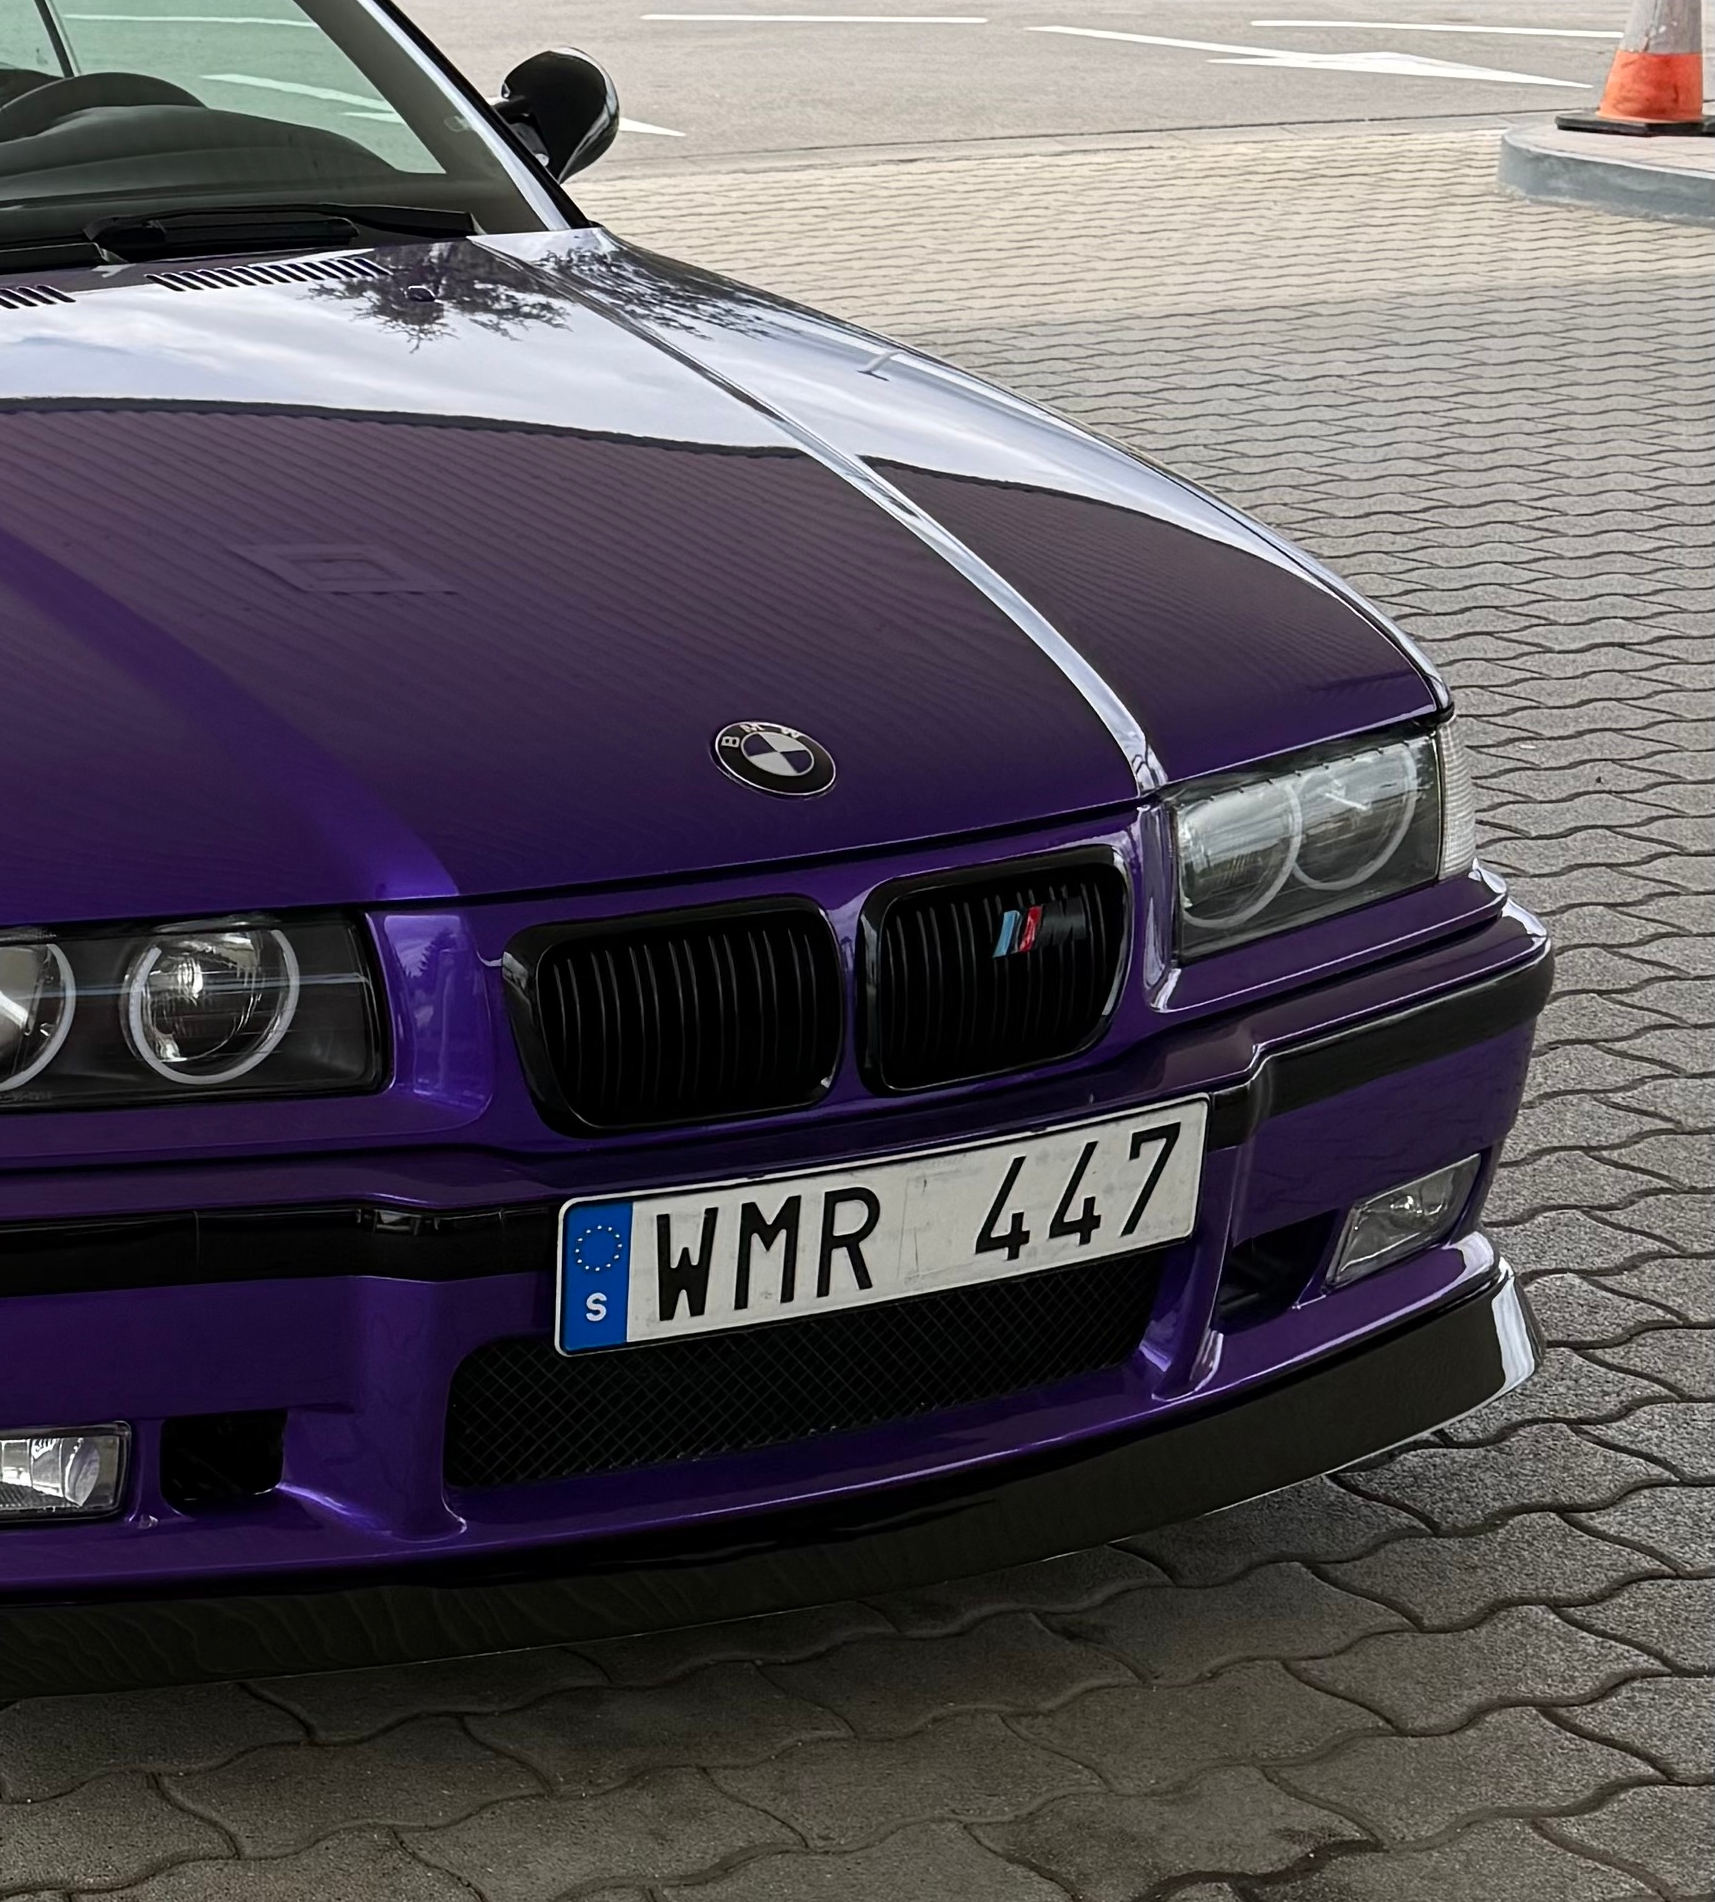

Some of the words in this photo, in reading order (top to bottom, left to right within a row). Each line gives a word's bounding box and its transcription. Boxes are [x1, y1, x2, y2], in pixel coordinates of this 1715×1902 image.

[720, 722, 802, 748] BMW
[655, 1186, 882, 1322] WMR
[974, 1121, 1182, 1261] 447
[585, 1293, 607, 1322] S
